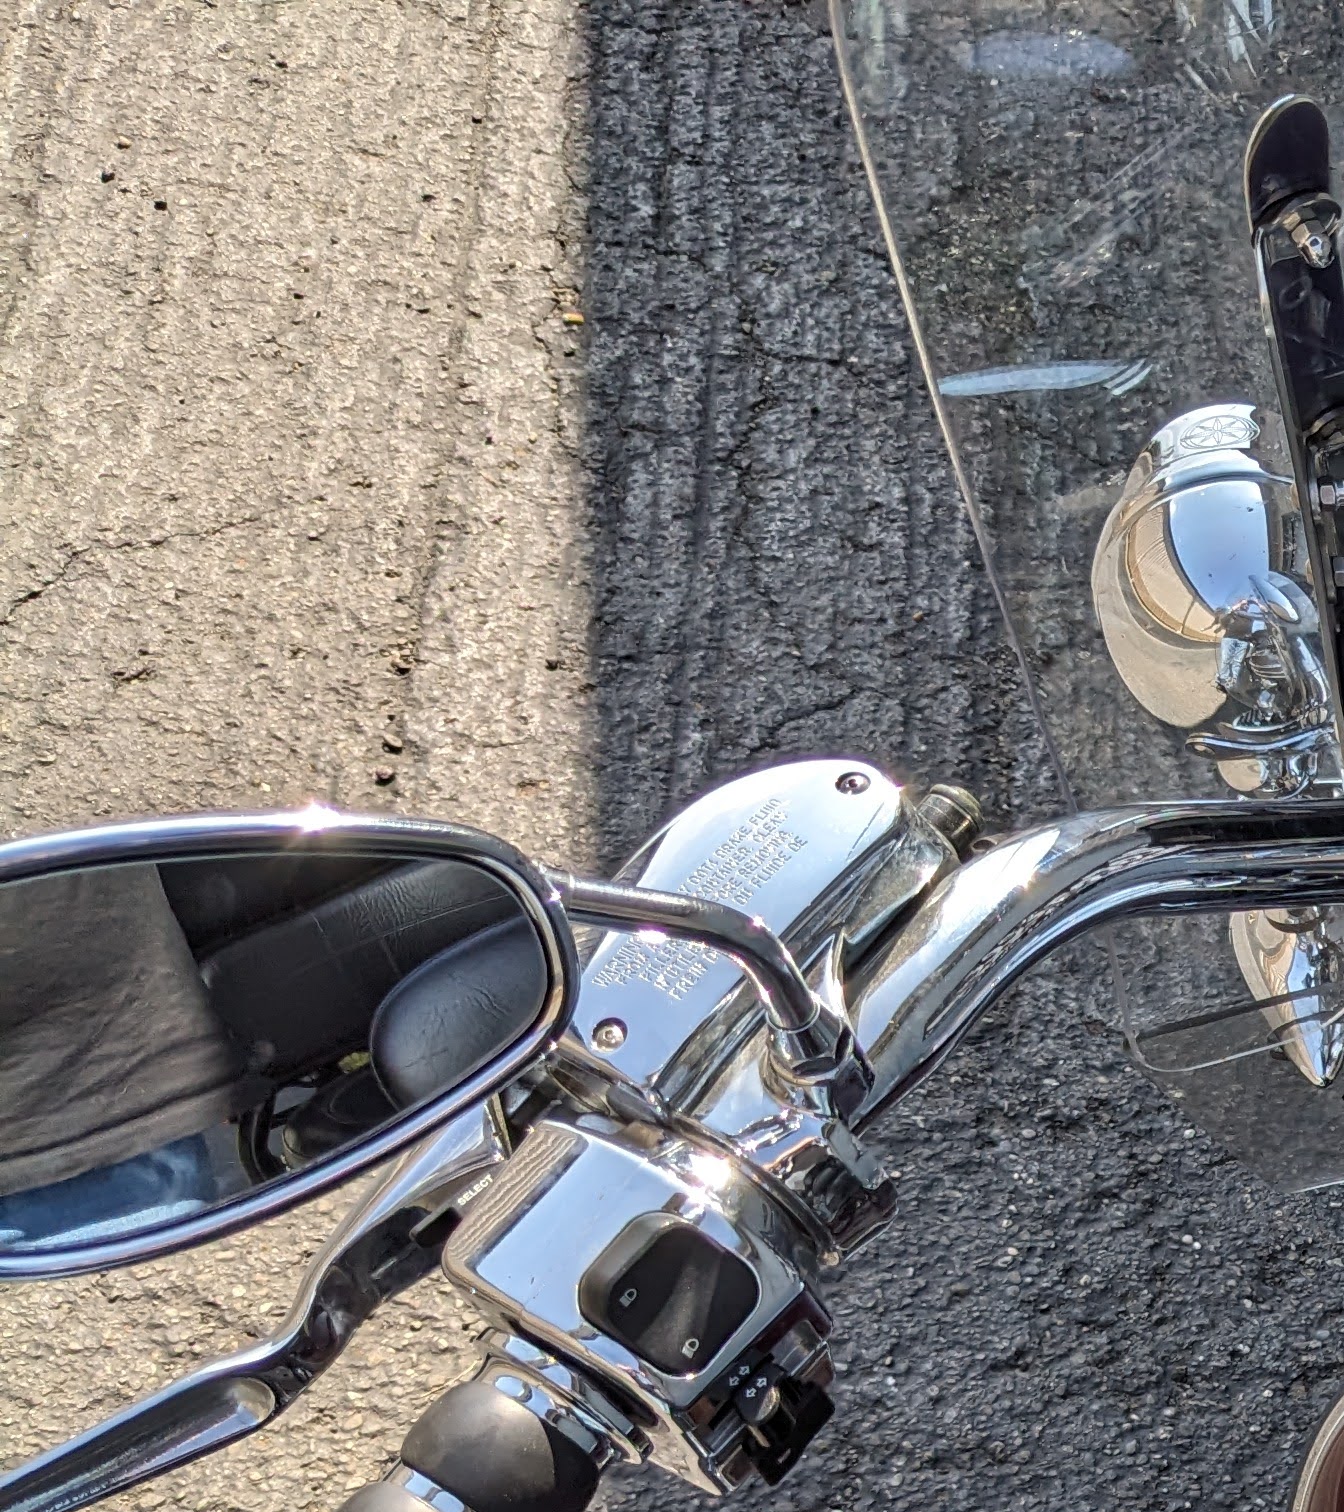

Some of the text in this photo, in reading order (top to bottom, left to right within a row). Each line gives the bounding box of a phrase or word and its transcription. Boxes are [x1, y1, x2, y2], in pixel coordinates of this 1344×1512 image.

[713, 825, 752, 859] BRAKE
[747, 798, 784, 826] FLUID
[749, 850, 793, 889] FLUIDE
[784, 835, 809, 853] DE
[592, 936, 643, 987] WARNIN
[614, 952, 649, 986] FROM
[457, 1173, 494, 1206] SELECT
